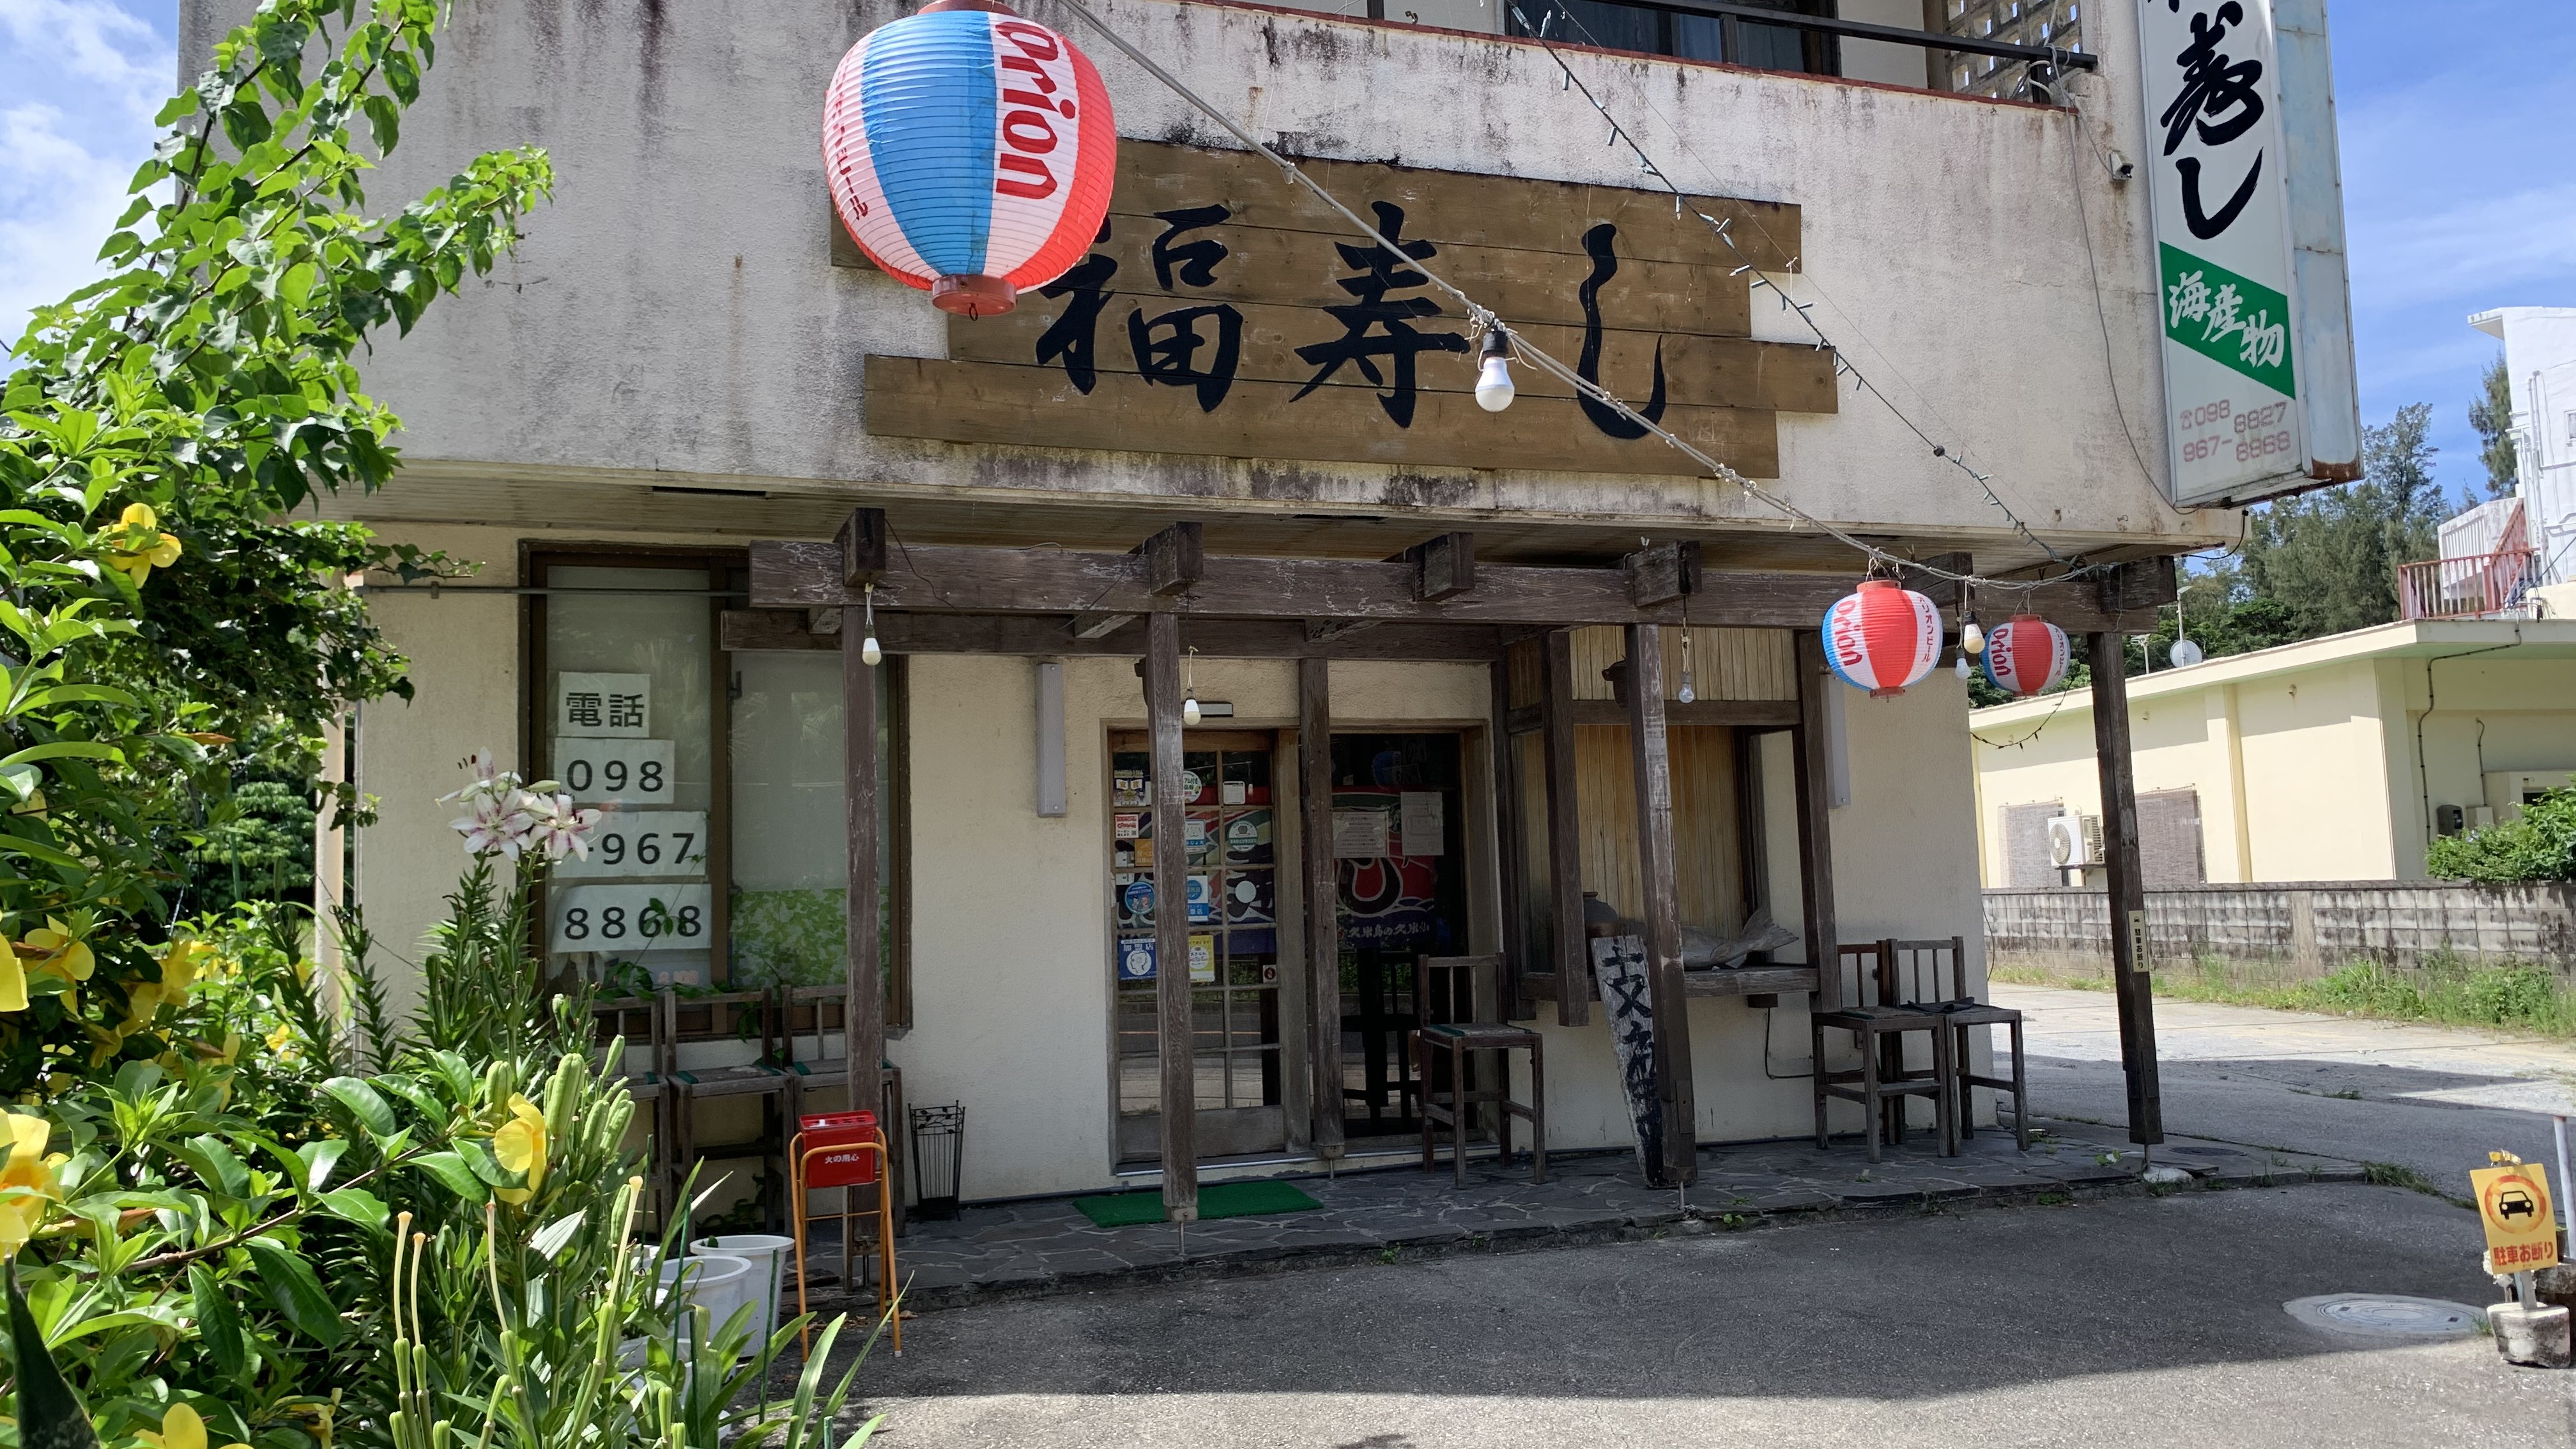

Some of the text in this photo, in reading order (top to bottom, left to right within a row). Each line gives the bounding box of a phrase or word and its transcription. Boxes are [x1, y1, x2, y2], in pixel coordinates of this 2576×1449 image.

[995, 21, 1076, 200] Orion
[2159, 0, 2264, 240] 寿し
[1036, 201, 1666, 440] 福寿し
[2168, 270, 2285, 368] 海産物
[2195, 399, 2230, 426] 098
[1832, 599, 1863, 666] Orion
[1917, 597, 1934, 663] オリオンビール
[1992, 628, 2012, 677] Orion
[565, 692, 645, 728] 電話
[567, 760, 664, 792] 098
[565, 905, 702, 940] 8868
[1347, 921, 1430, 939] 久米島の久米仙
[824, 1153, 859, 1164] 火の用心
[2493, 1241, 2554, 1267] 駐車お断り
